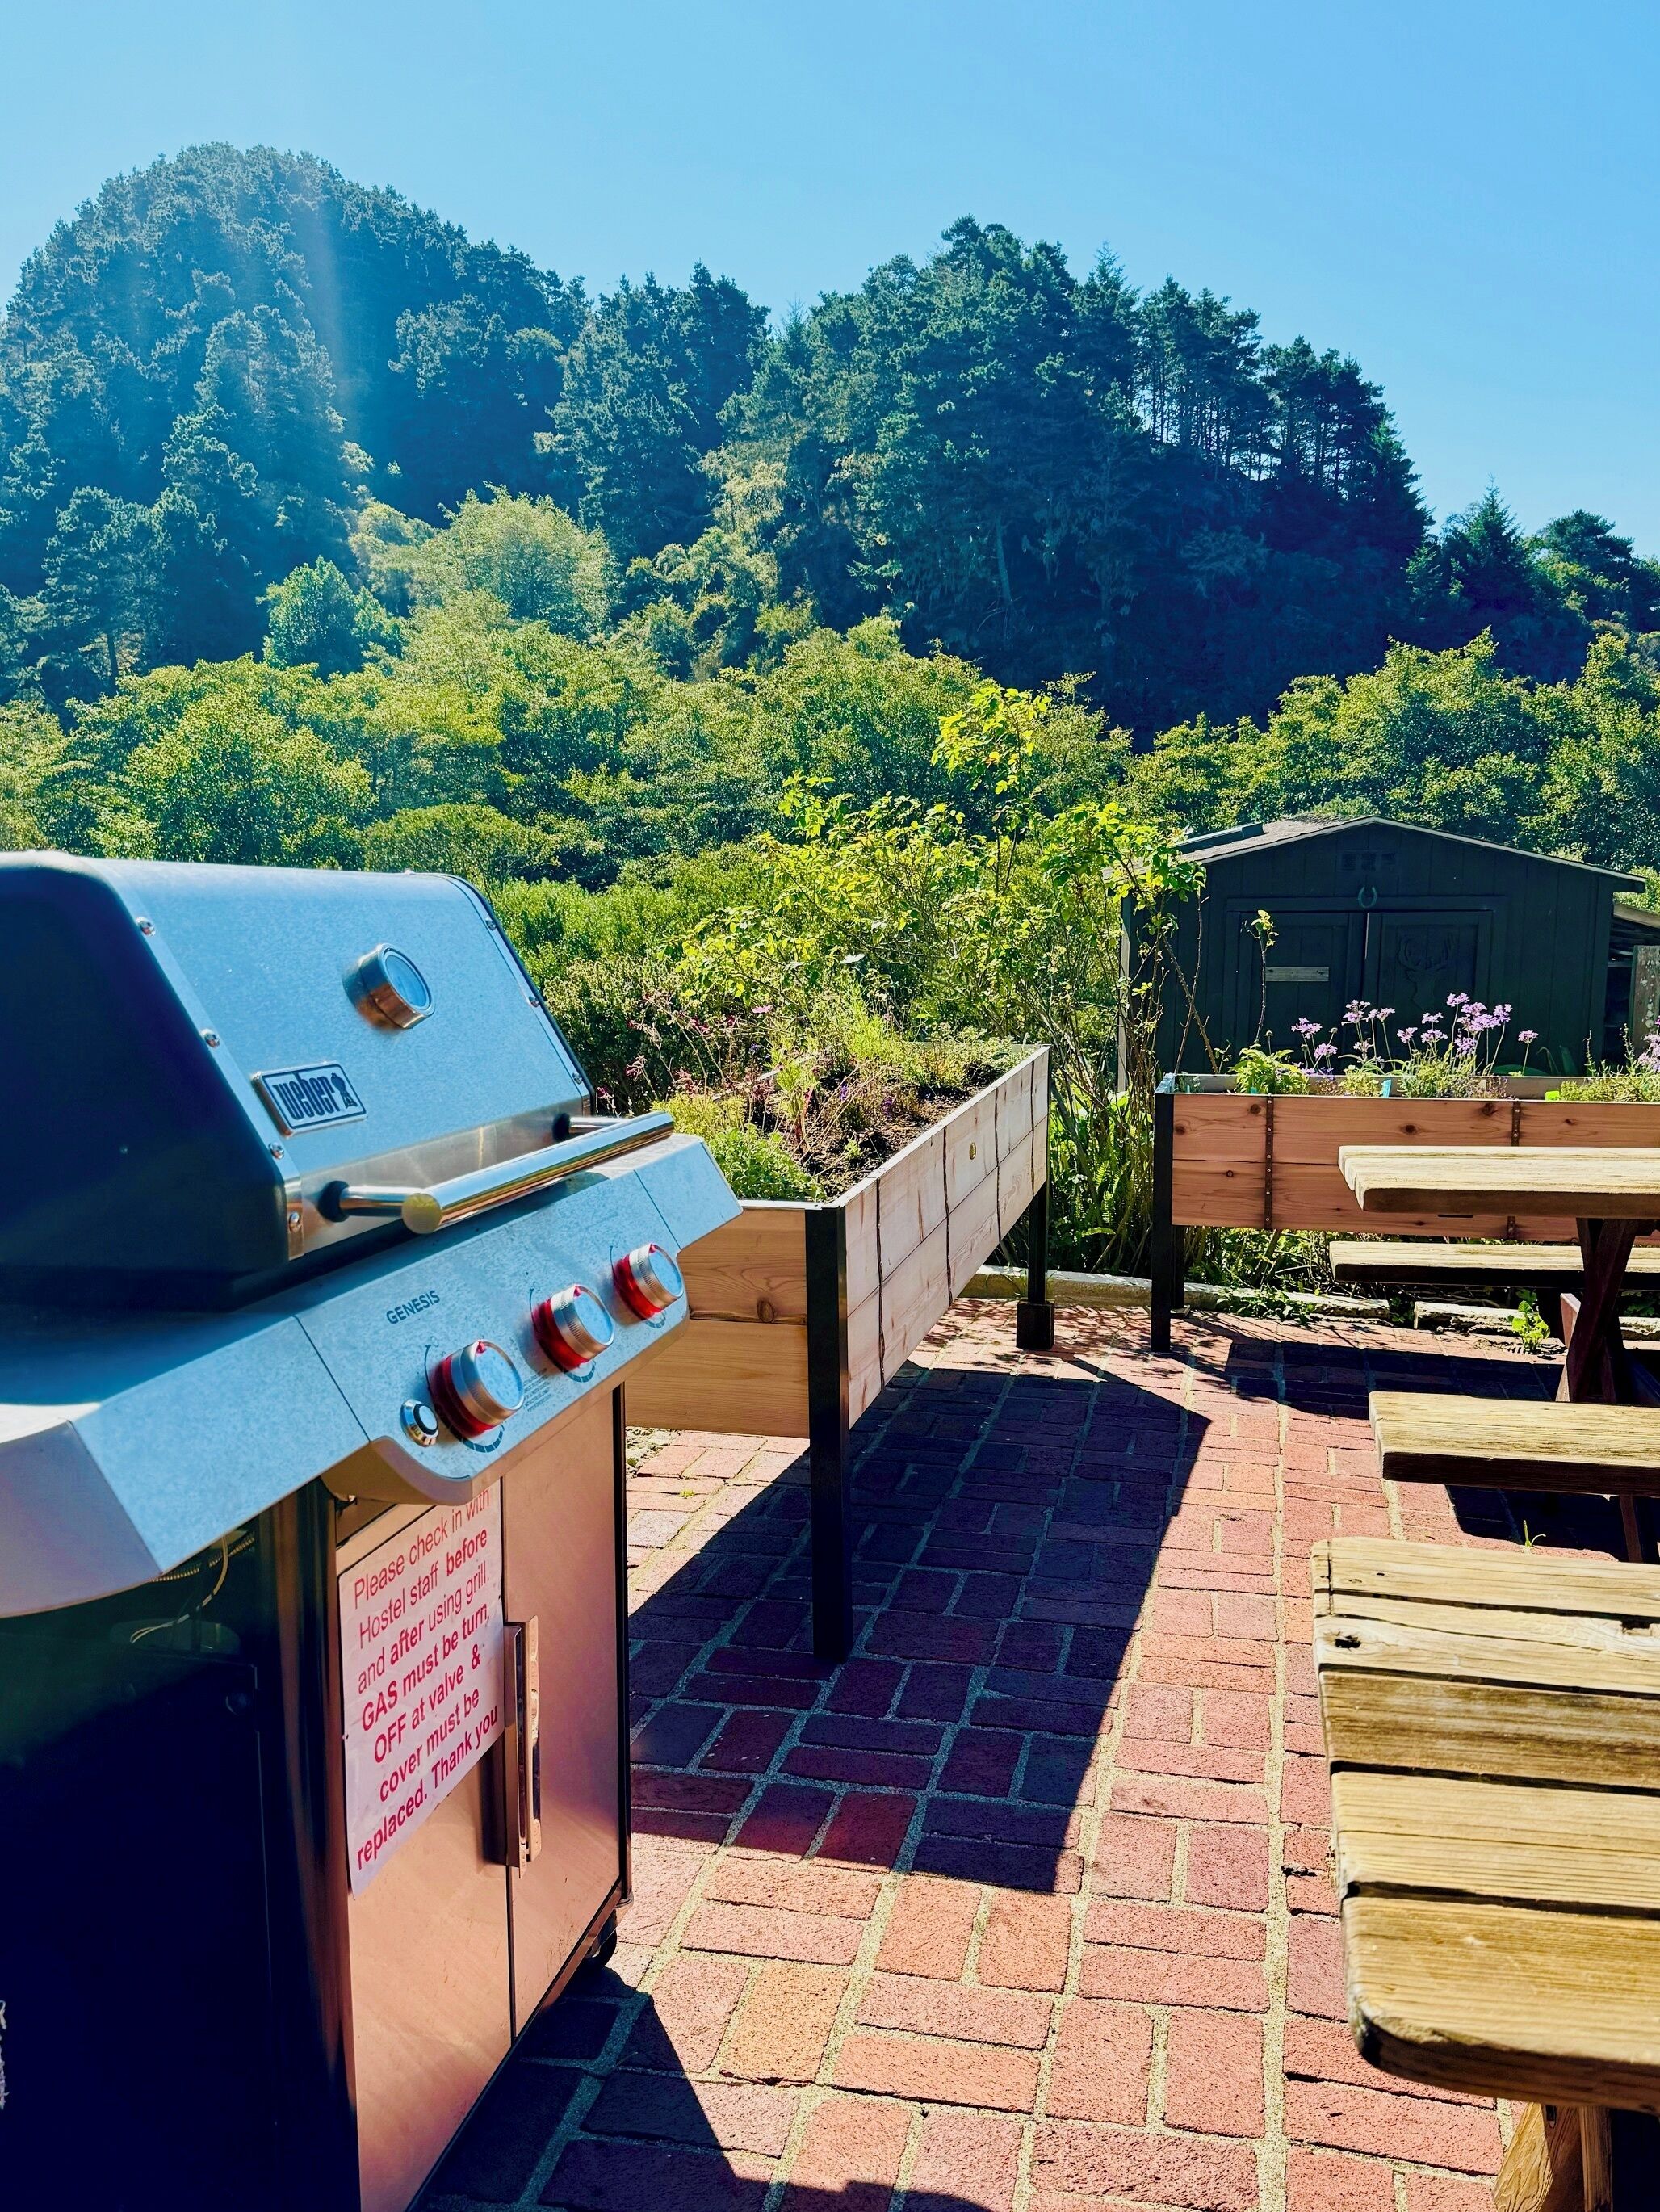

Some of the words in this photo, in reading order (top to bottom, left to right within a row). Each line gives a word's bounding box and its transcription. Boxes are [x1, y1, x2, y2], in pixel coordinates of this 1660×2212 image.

[272, 1072, 340, 1119] weber
[387, 1291, 440, 1324] GENESIS
[354, 1555, 405, 1610] Please
[409, 1517, 448, 1565] check
[452, 1509, 462, 1533] in
[359, 1588, 405, 1649] Hostel
[410, 1560, 438, 1605] staff
[446, 1529, 488, 1576] before
[358, 1647, 385, 1694] and
[390, 1619, 424, 1665] after
[429, 1588, 462, 1631] using
[466, 1560, 489, 1605] grill.
[363, 1681, 398, 1731] GAS
[403, 1643, 438, 1696] must
[443, 1631, 459, 1660] be
[375, 1712, 406, 1763] OFF
[412, 1698, 425, 1729] at
[429, 1665, 463, 1710] valve
[472, 1644, 480, 1669] &
[379, 1745, 422, 1802] cover
[426, 1703, 460, 1757] must
[464, 1689, 479, 1718] be
[357, 1779, 427, 1870] replaced.
[431, 1731, 472, 1788] Thank
[476, 1705, 497, 1750] you
